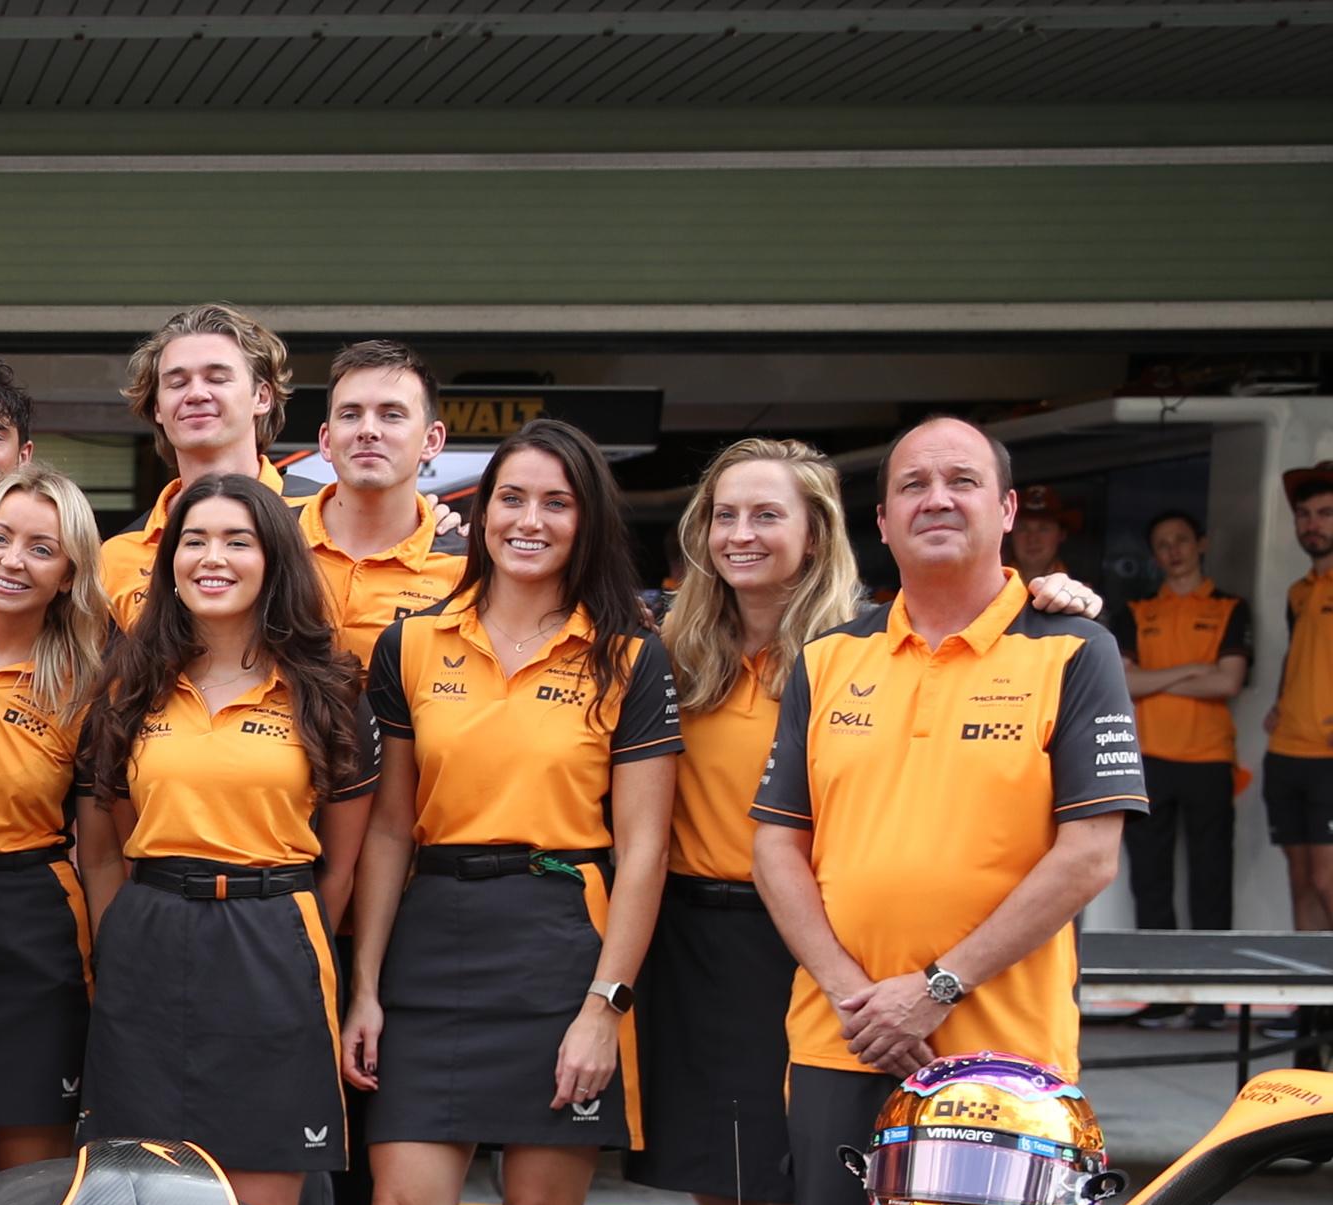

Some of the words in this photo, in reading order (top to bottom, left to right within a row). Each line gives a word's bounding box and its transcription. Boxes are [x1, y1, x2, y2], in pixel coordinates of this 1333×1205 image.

[439, 401, 544, 433] WALT
[433, 682, 467, 694] DELL
[969, 693, 1032, 702] McLaren
[829, 711, 874, 727] DELL
[961, 724, 1023, 741] OKX
[934, 1100, 1001, 1120] OKX
[927, 1127, 994, 1142] vmware
